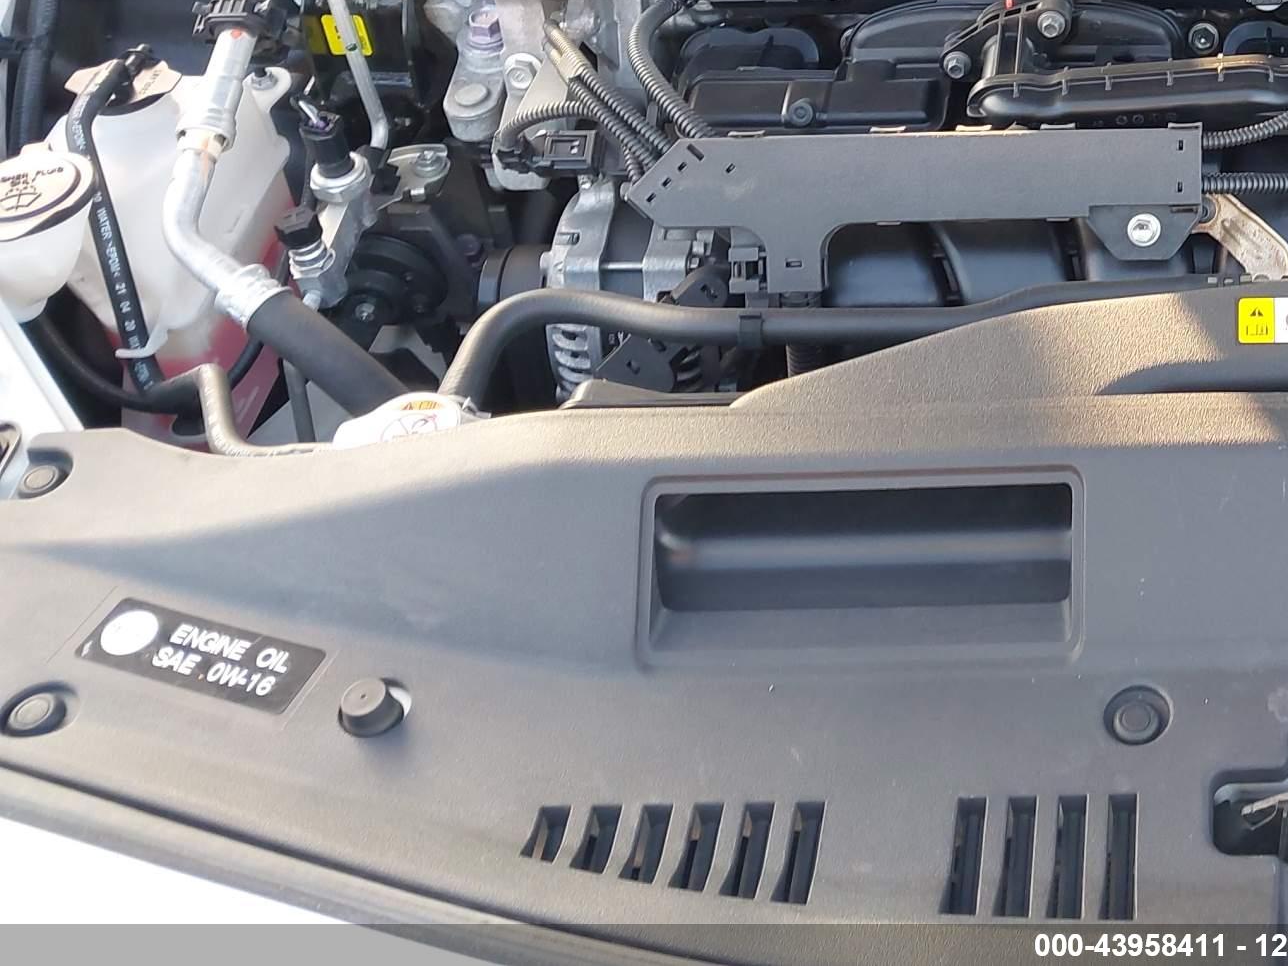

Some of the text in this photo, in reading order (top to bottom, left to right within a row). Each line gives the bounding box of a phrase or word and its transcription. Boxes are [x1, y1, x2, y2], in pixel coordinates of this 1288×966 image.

[96, 207, 113, 240] WATER
[151, 646, 277, 697] SAE 0W-16
[169, 623, 290, 674] ENGINE OIL
